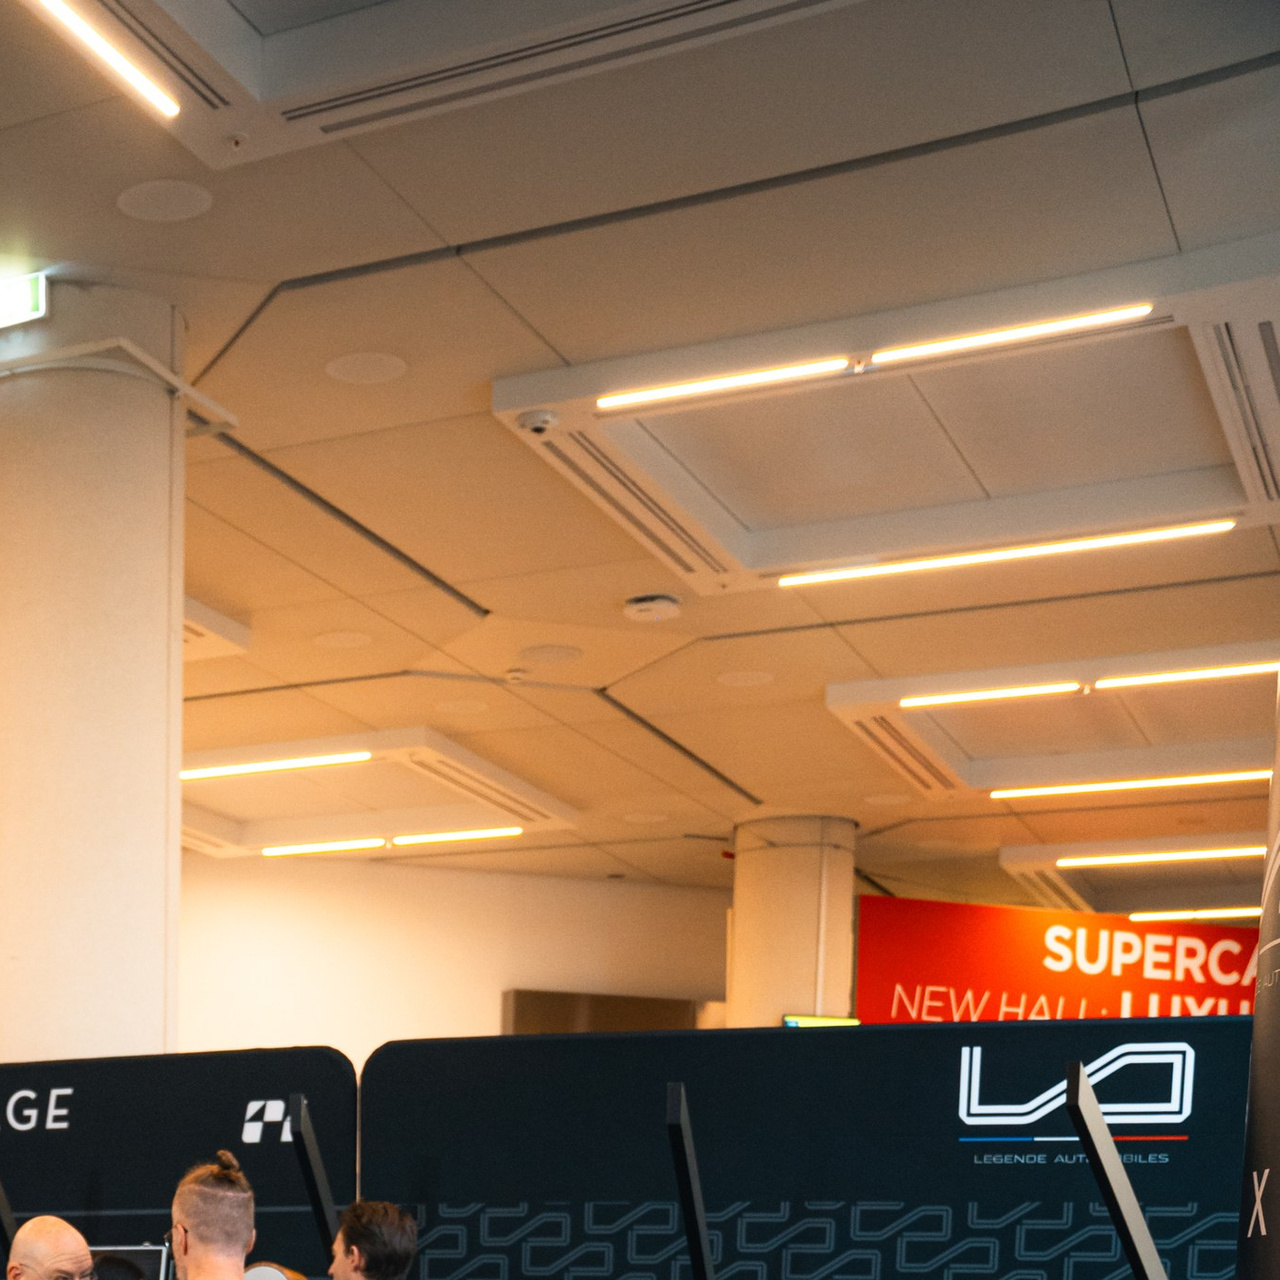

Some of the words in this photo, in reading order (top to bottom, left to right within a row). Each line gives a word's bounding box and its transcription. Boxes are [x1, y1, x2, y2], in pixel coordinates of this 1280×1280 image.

[891, 984, 991, 1021] NEW
[973, 1153, 1047, 1165] LEGENDE
[1053, 1153, 1169, 1164] AUTBILES
